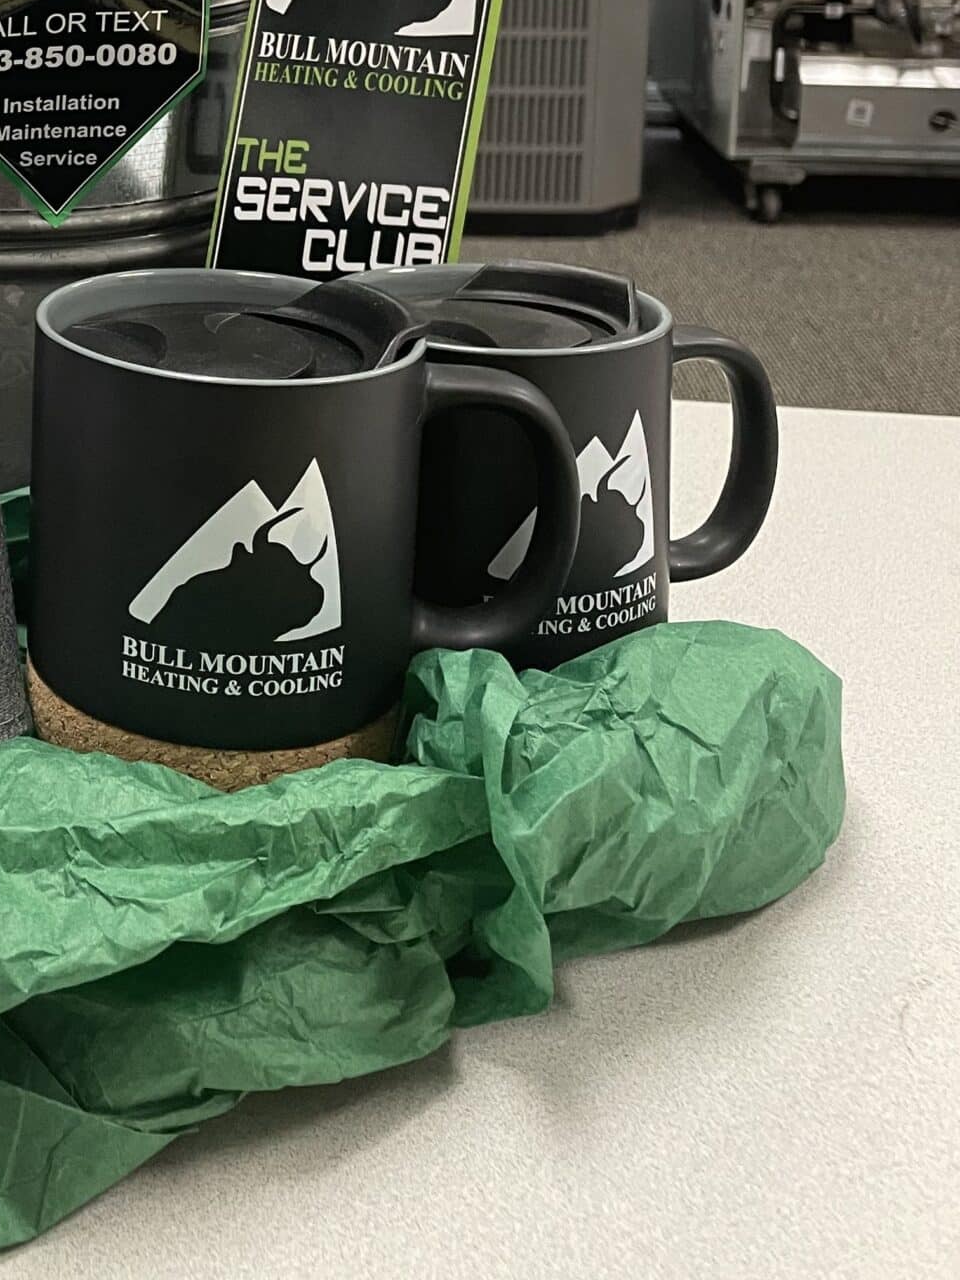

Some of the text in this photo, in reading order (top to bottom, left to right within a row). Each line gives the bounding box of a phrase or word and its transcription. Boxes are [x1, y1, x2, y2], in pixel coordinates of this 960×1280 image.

[45, 12, 87, 35] OR
[95, 9, 169, 33] TEXT
[257, 30, 472, 80] BULL MOUNTAIN
[253, 60, 465, 102] HEATING & COOLING
[2, 93, 121, 115] Installation
[18, 148, 99, 168] Service
[237, 136, 311, 175] THE
[233, 175, 451, 231] SERVICE
[301, 227, 443, 273] CLUB
[555, 571, 657, 616] MOUNTAIN
[577, 616, 592, 633] &
[595, 594, 657, 631] COOLING
[121, 634, 346, 676] BULL MOUNTAIN
[121, 659, 344, 698] HEATING & COOLING
